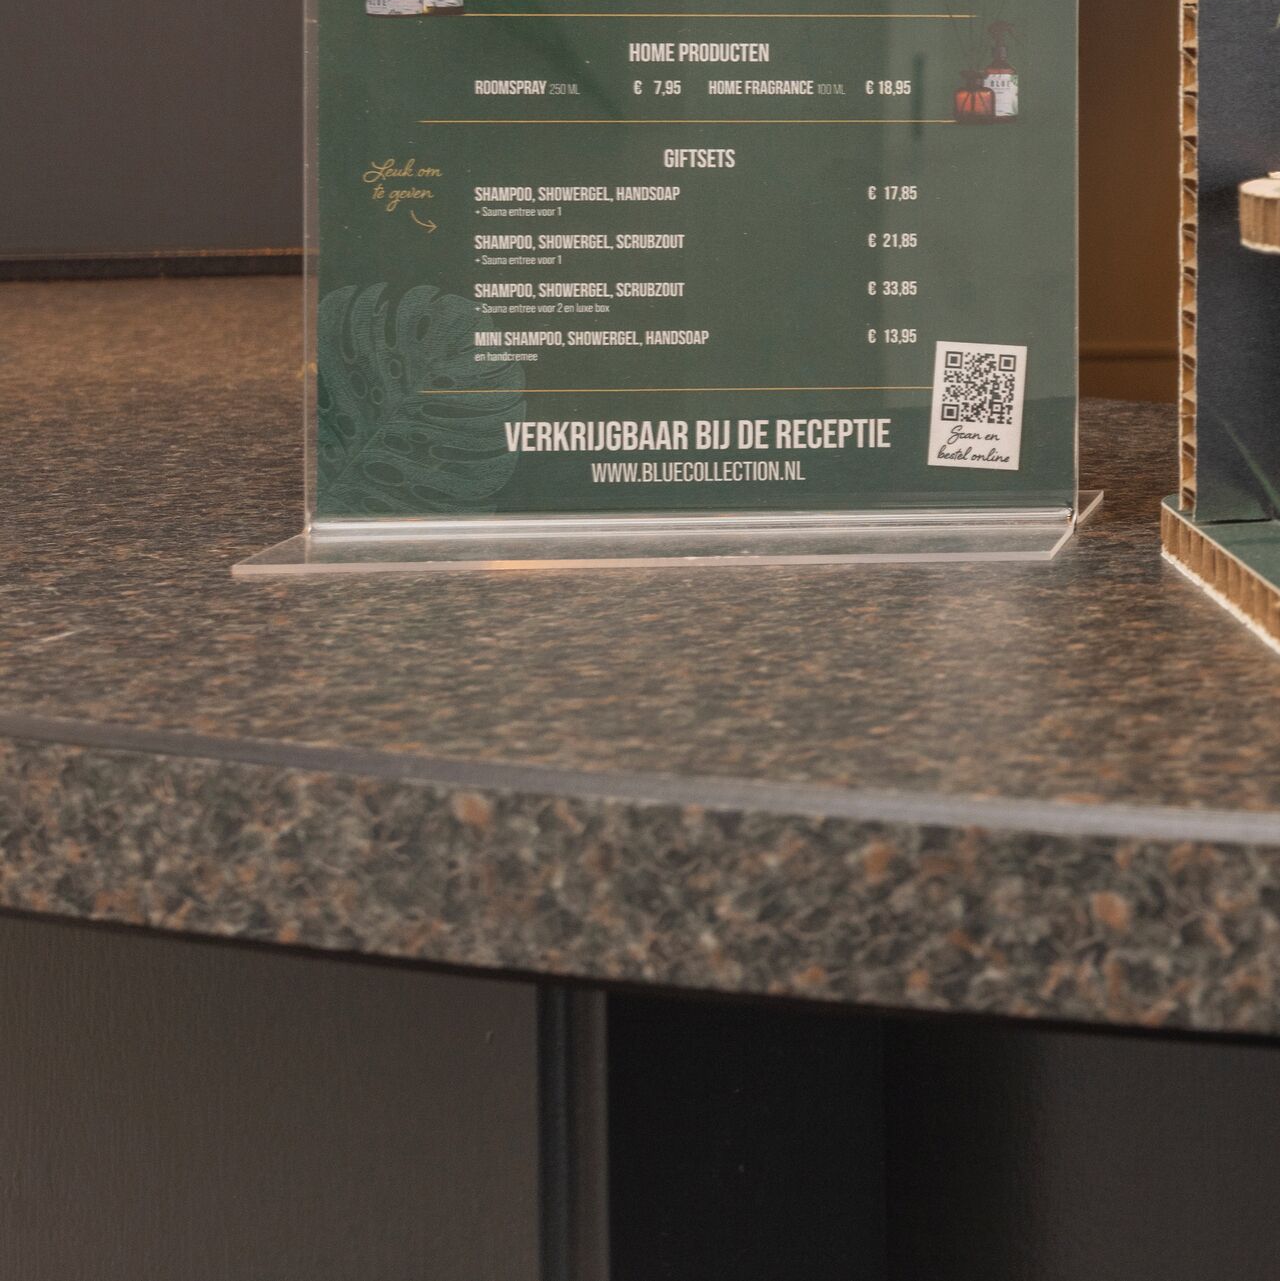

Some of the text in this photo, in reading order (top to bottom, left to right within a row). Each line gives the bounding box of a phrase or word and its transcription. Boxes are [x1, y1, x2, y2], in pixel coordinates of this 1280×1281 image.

[629, 43, 770, 62] HOME PRODUCTEN
[474, 80, 547, 95] ROOMSPRAY
[549, 83, 566, 95] 250
[633, 80, 642, 95] €
[654, 80, 682, 96] 7,95
[708, 80, 742, 95] HOME
[745, 80, 814, 95] FRAGRANCE
[865, 80, 874, 95] €
[878, 80, 911, 96] 18,95
[663, 148, 736, 168] GIFTSETS
[363, 158, 443, 183] Leuk om
[372, 184, 434, 212] te geven
[474, 186, 681, 203] SHAMPOO, SHOWERGEL, HANDSOAP
[868, 185, 918, 201] € 17,85
[481, 206, 507, 217] Sauna
[508, 206, 536, 217] entree
[537, 208, 556, 217] voor
[474, 234, 685, 251] SHAMPOO, SHOWERGEL, SCRUBZOUT
[868, 233, 918, 249] € 21,85
[481, 254, 507, 265] Sauna
[508, 254, 536, 265] entree
[537, 257, 556, 265] voor
[474, 282, 685, 299] SHAMPOO, SHOWERGEL, SCRUBZOUT
[868, 280, 918, 297] € 33,85
[481, 303, 507, 314] Sauna
[508, 303, 536, 314] entree
[537, 305, 556, 313] voor
[564, 304, 575, 313] en
[576, 302, 594, 313] luxe
[595, 302, 610, 313] box
[474, 330, 710, 347] MINI SHAMPOO, SHOWERGEL, HANDSOAP
[868, 328, 917, 345] € 13,95
[474, 353, 486, 361] en
[505, 418, 892, 452] VERKRIJGBAAR BIJ DE RECEPTIE
[947, 425, 1000, 445] Scan en
[937, 444, 1010, 463] bestel online
[591, 461, 806, 484] WWW.BLUECOLLECTION.NL
